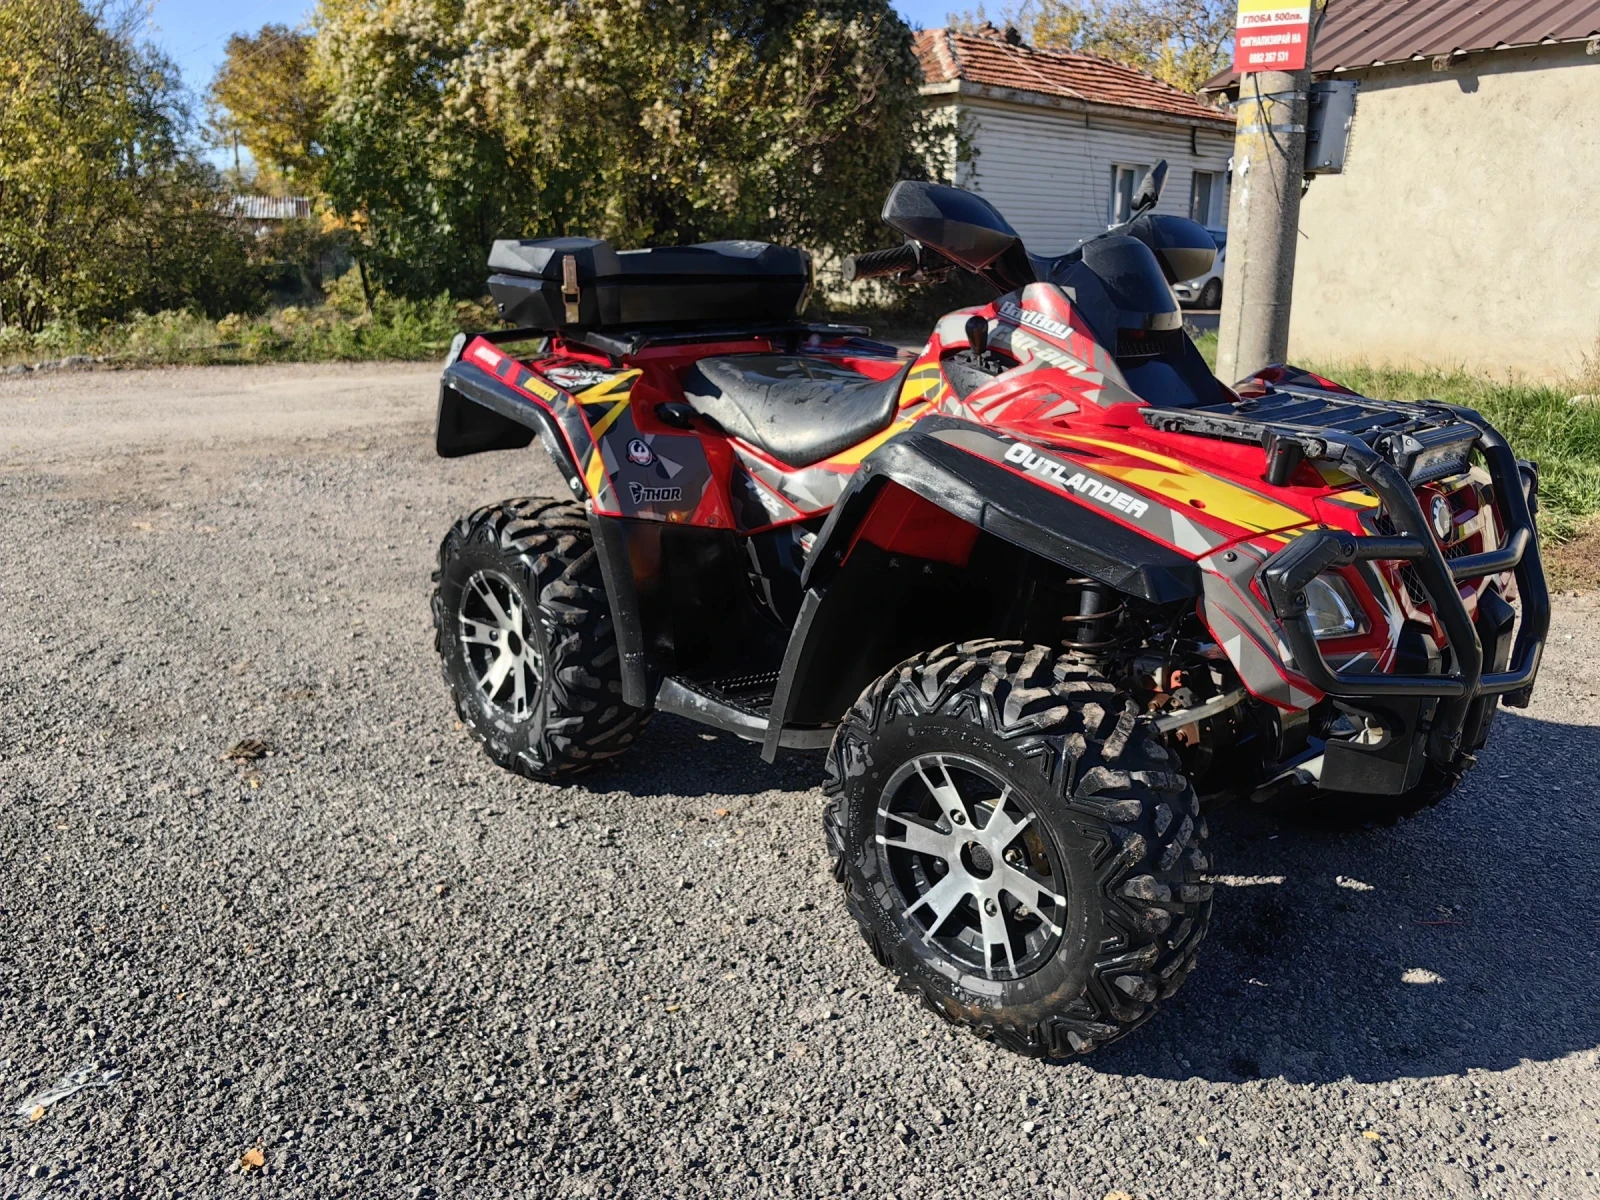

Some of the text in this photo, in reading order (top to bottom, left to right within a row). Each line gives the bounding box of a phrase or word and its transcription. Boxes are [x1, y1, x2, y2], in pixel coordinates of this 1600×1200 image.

[1242, 14, 1272, 24] ГЛОБА
[1240, 32, 1302, 48] СИГНАЛИЗИРАЙ НА
[998, 301, 1075, 340] BadBoy
[1004, 442, 1149, 519] OUTLANDER
[643, 487, 682, 502] THOR
